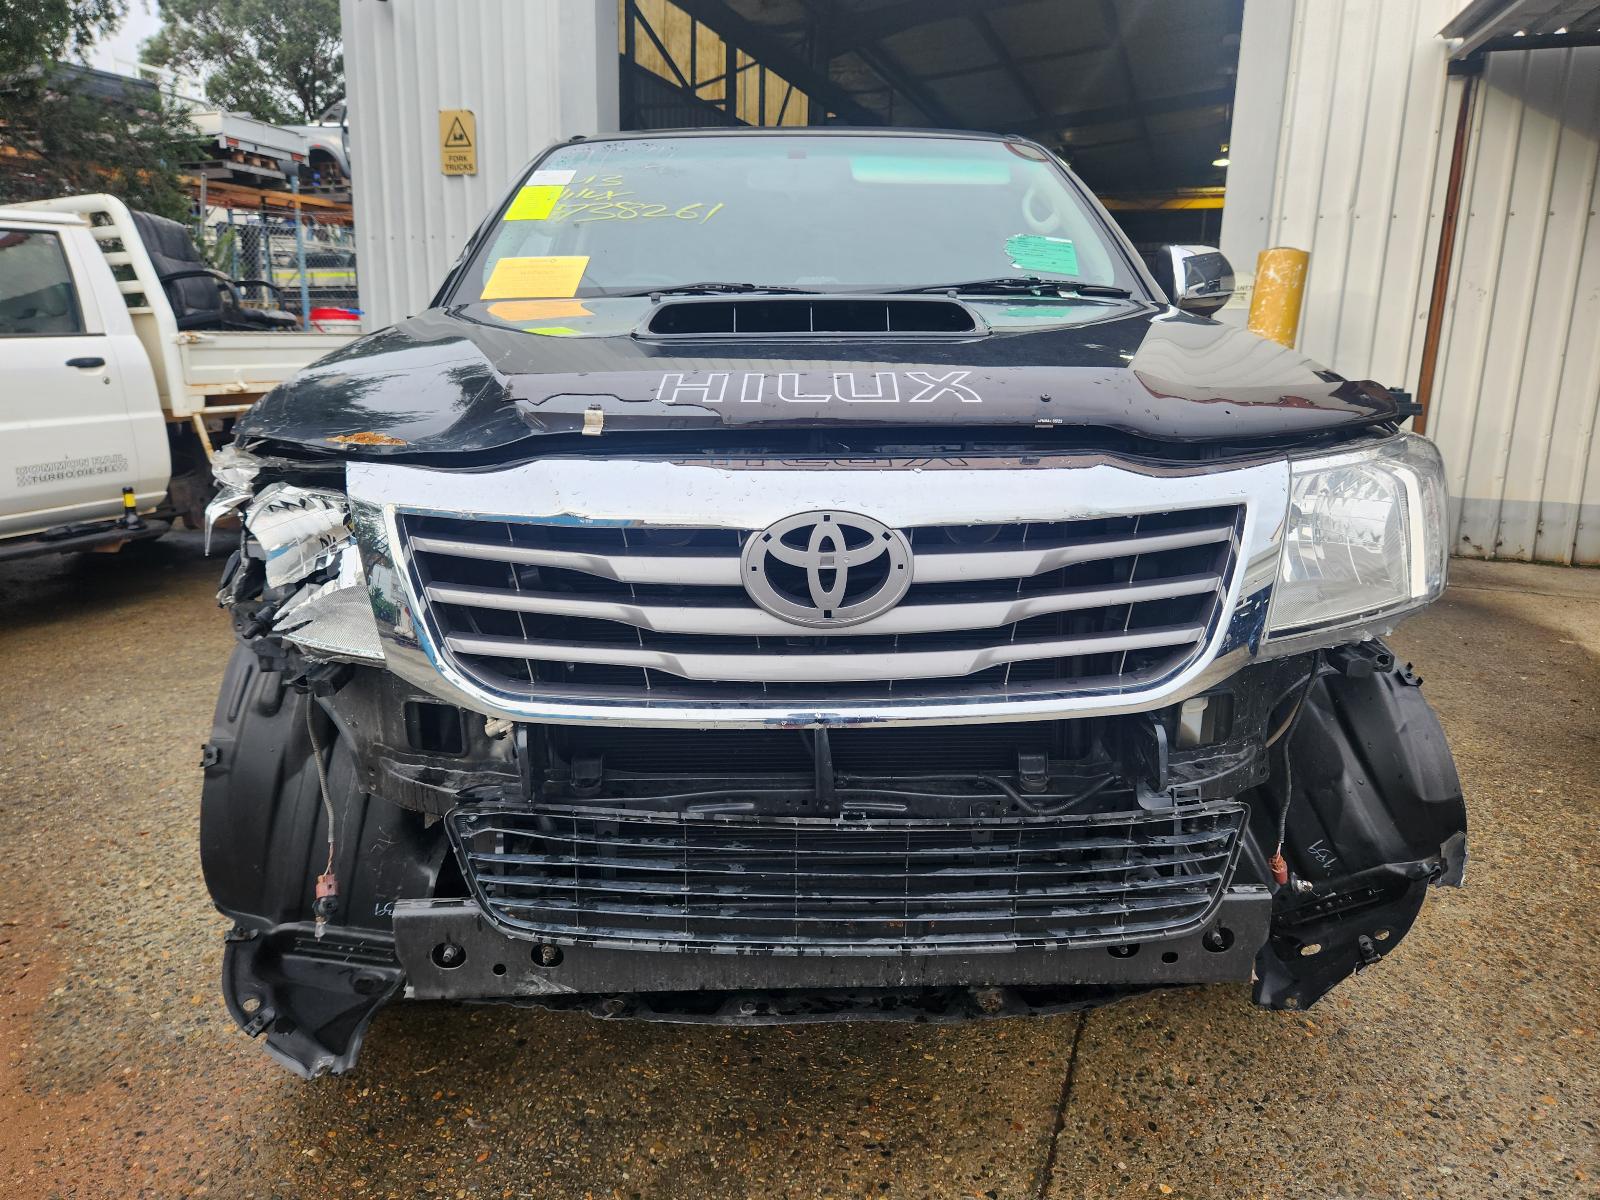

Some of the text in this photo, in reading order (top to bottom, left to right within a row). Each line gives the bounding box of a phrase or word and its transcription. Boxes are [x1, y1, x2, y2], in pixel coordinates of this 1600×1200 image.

[448, 155, 468, 163] FORK
[445, 163, 474, 171] TRUCKS
[655, 371, 983, 403] HILUX
